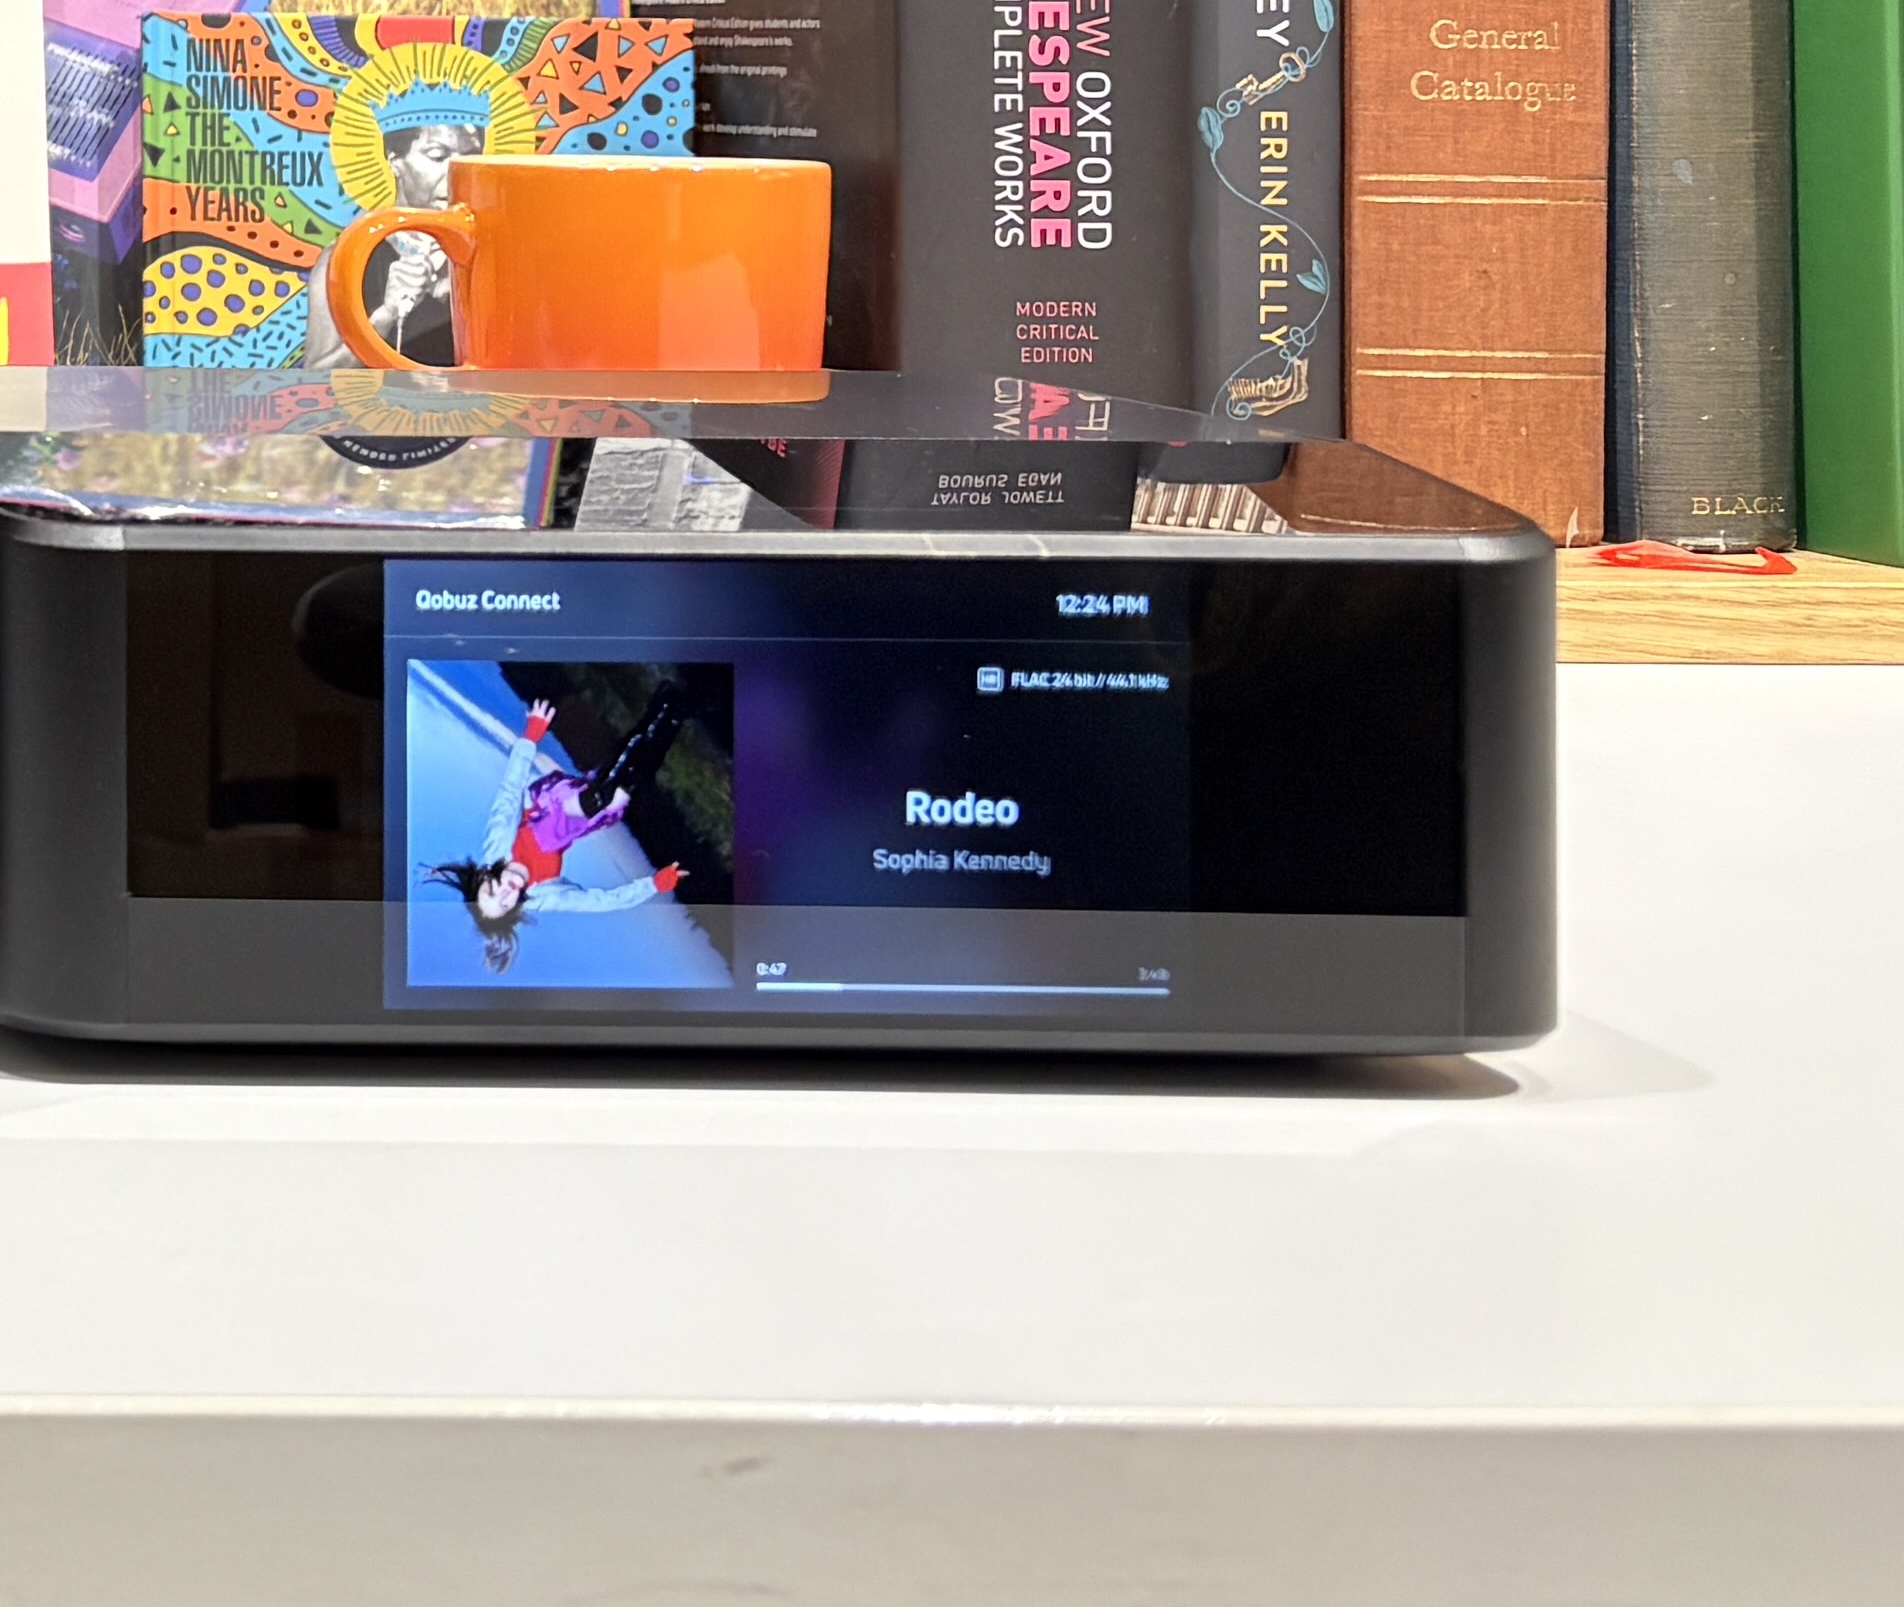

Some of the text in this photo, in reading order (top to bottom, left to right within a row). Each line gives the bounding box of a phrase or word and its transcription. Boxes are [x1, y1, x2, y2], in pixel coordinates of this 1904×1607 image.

[1429, 19, 1561, 50] General
[185, 39, 248, 73] NINA
[185, 76, 282, 112] SIMONE
[1410, 70, 1577, 112] Catalogue
[186, 112, 231, 148] THE
[186, 150, 324, 188] MONTREUX
[1076, 71, 1113, 250] OXFORD
[994, 122, 1024, 249] WORKS
[186, 186, 266, 223] YEARS
[1259, 110, 1290, 349] ERIN KELLY
[1015, 301, 1098, 318] MODERN
[1015, 324, 1099, 341] CRITICAL
[1020, 346, 1094, 364] EDITION
[1691, 496, 1786, 516] BLACK
[415, 589, 561, 612] Qobuz Connect
[1056, 593, 1151, 617] 12:24 PM
[1011, 671, 1049, 688] FLAC
[905, 790, 1020, 826] Rodeo
[872, 847, 1052, 878] Sophia Kennedy
